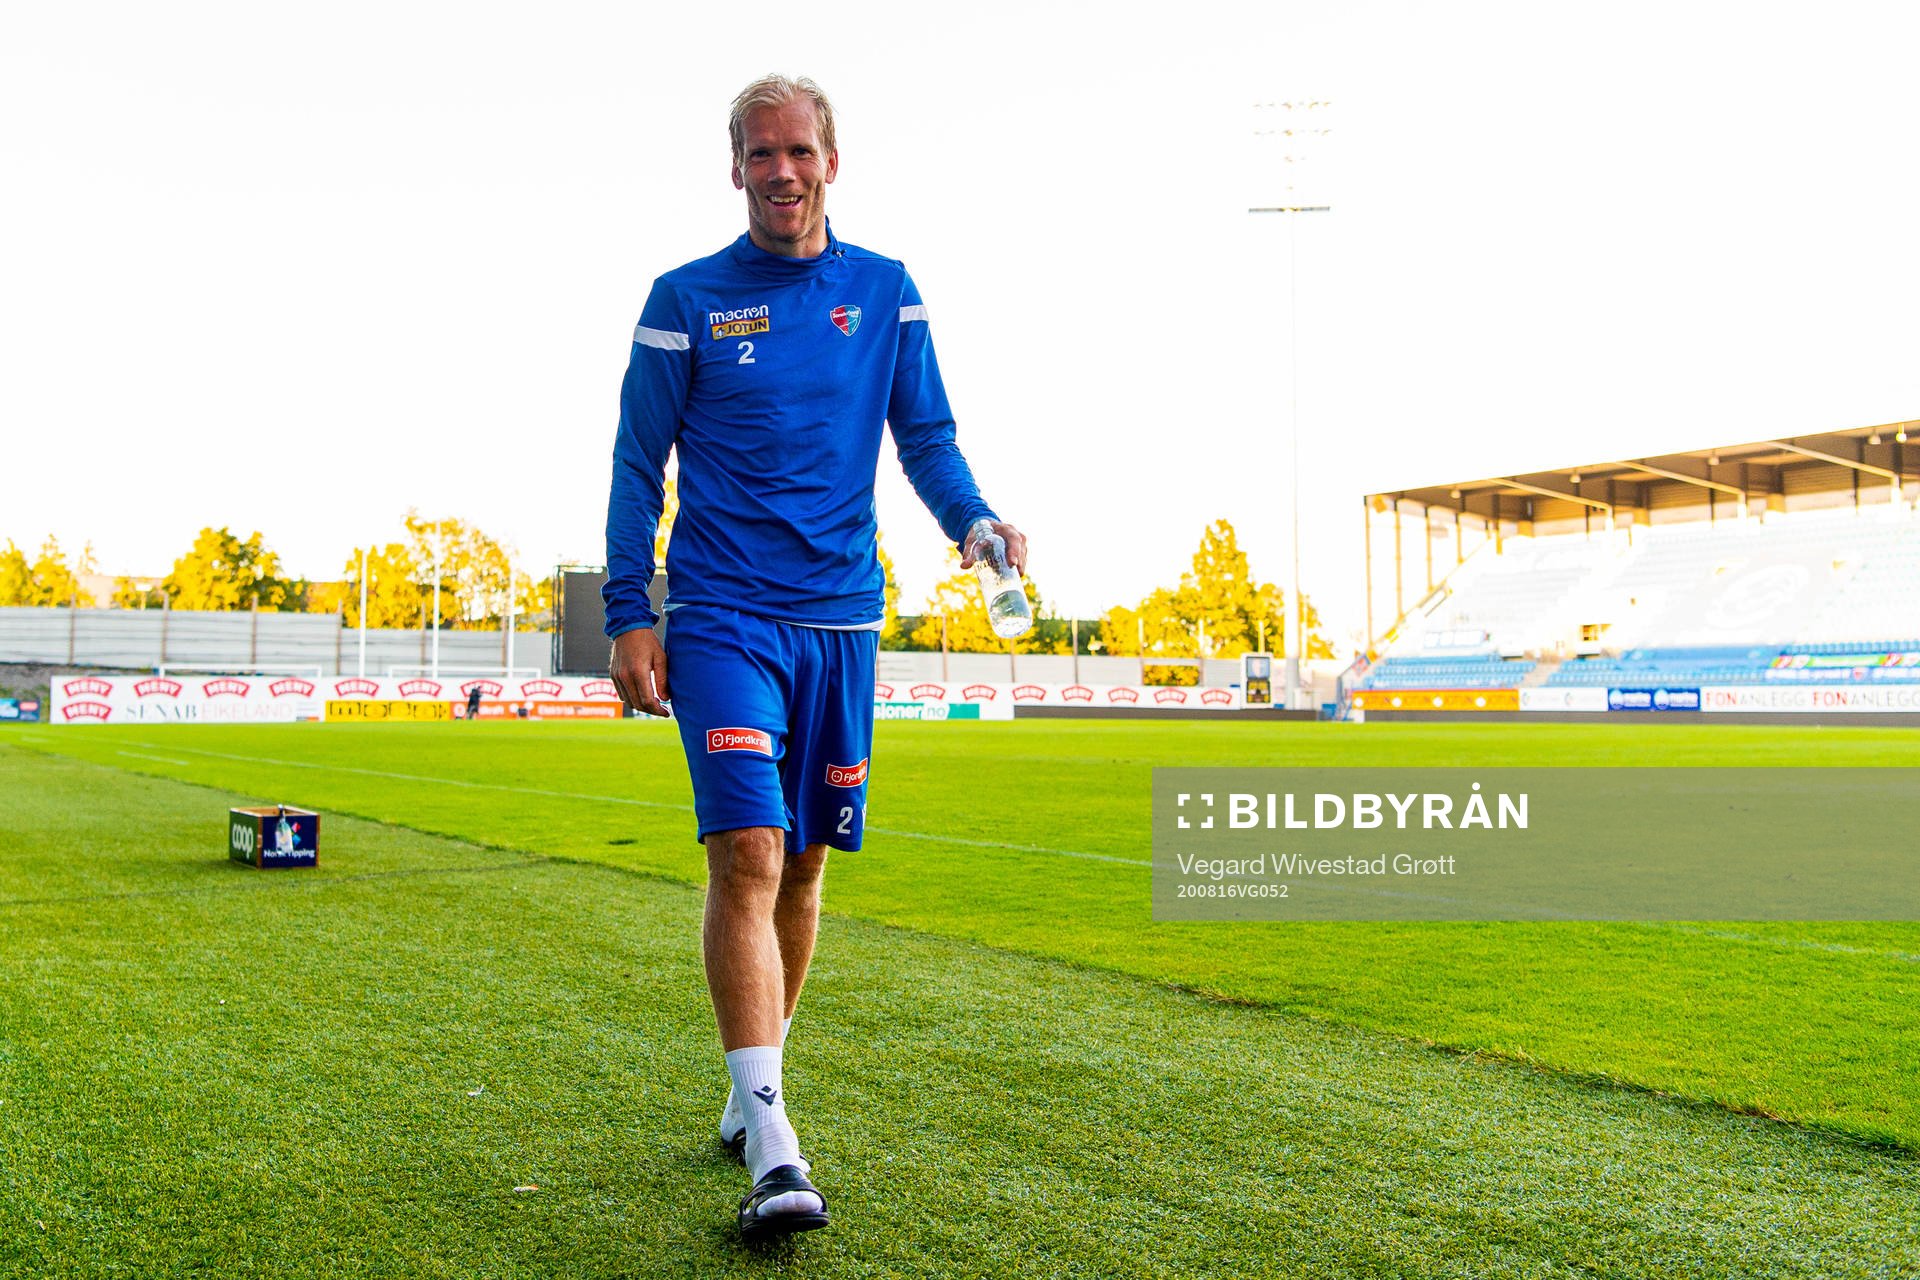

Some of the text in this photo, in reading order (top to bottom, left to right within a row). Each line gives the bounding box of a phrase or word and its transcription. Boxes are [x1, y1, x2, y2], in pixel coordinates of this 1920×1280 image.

[709, 304, 769, 325] macron
[727, 319, 767, 335] JOTUN
[737, 340, 756, 365] 2
[836, 806, 854, 834] 2
[232, 824, 253, 859] coop
